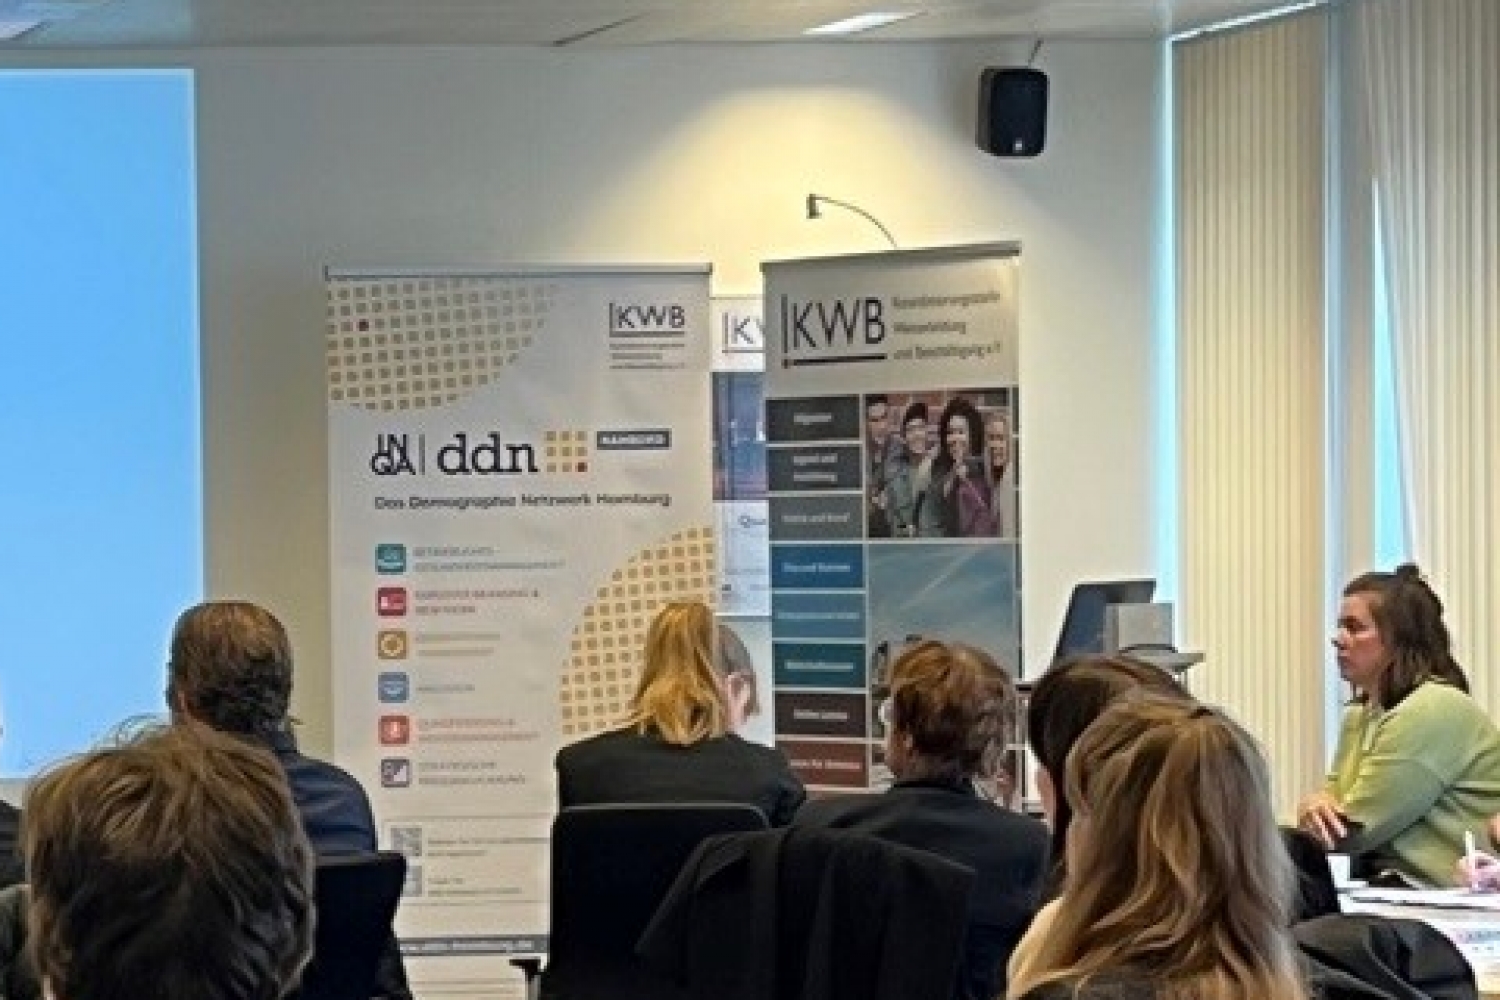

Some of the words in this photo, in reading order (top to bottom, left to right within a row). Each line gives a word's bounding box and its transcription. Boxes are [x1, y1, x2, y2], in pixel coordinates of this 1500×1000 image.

[616, 305, 685, 329] KWB
[793, 297, 885, 348] KWB
[436, 431, 540, 475] ddn
